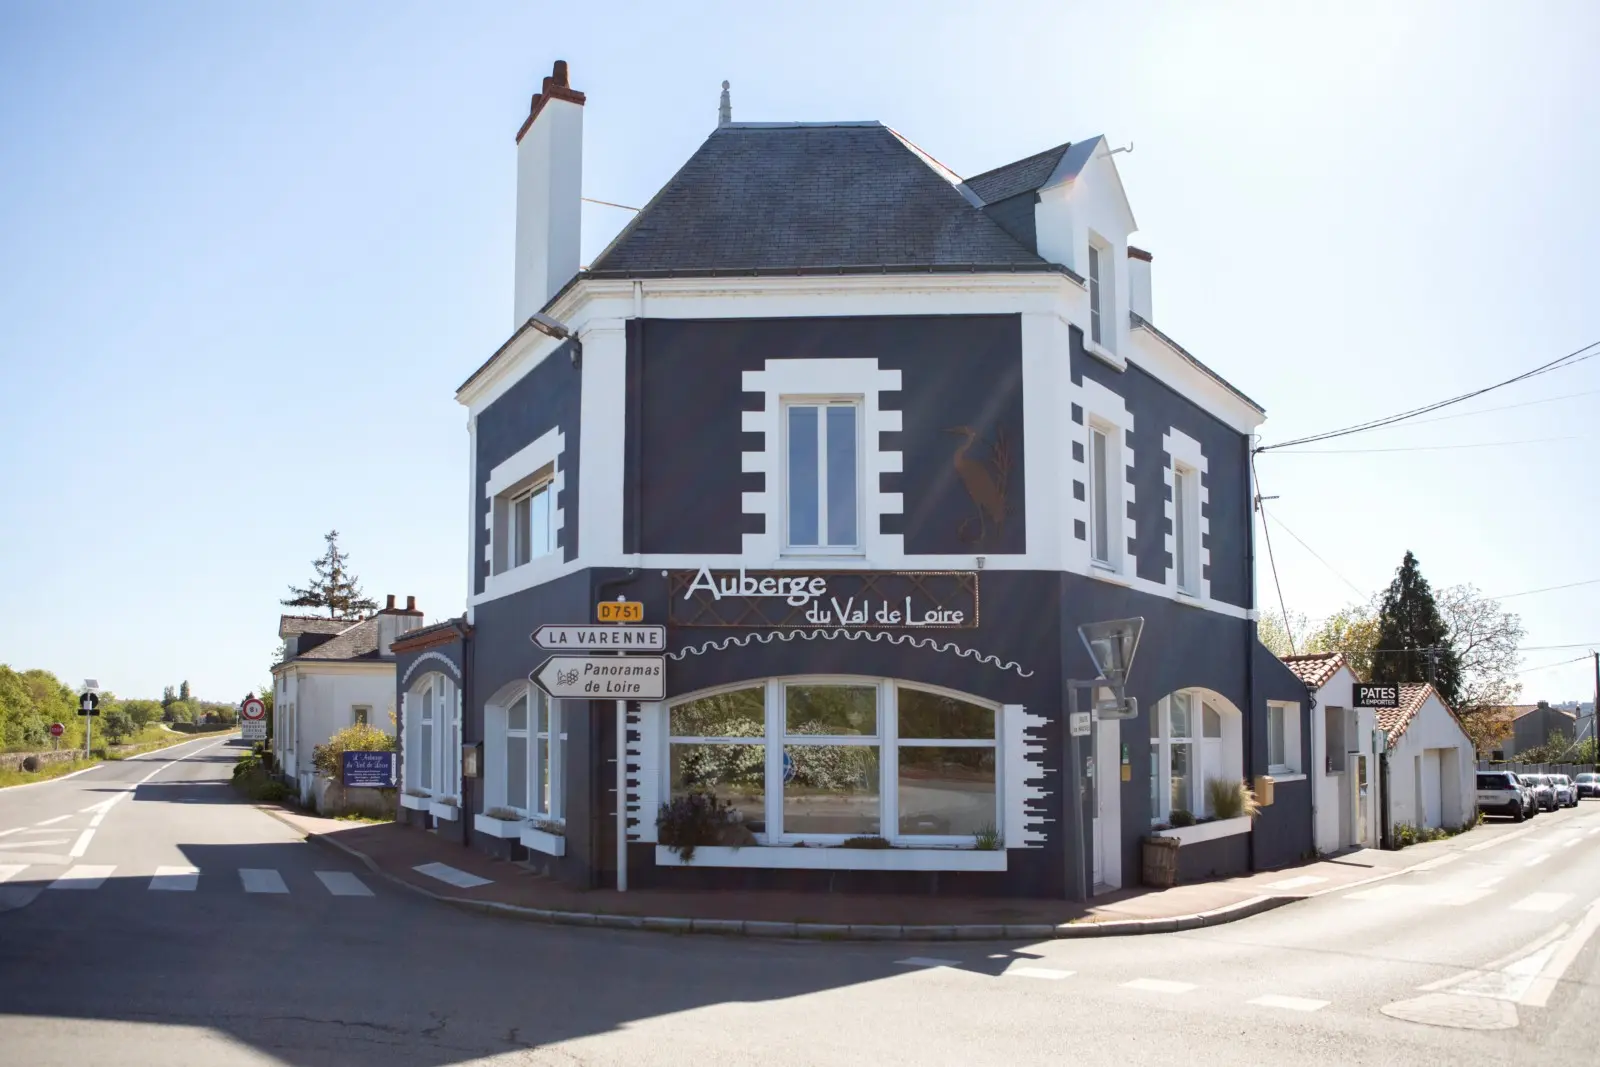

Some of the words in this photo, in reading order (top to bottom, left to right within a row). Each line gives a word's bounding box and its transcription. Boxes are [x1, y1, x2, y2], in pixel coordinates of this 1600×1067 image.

[684, 565, 826, 607] Auberge
[805, 600, 831, 624] du
[831, 596, 869, 626] Val
[875, 600, 901, 624] de
[905, 596, 964, 626] Loire
[549, 632, 567, 643] LA
[577, 632, 657, 644] VARENNE
[584, 663, 660, 676] Panoramas
[584, 681, 600, 692] de
[606, 681, 640, 692] Loire
[1360, 687, 1396, 699] PATES
